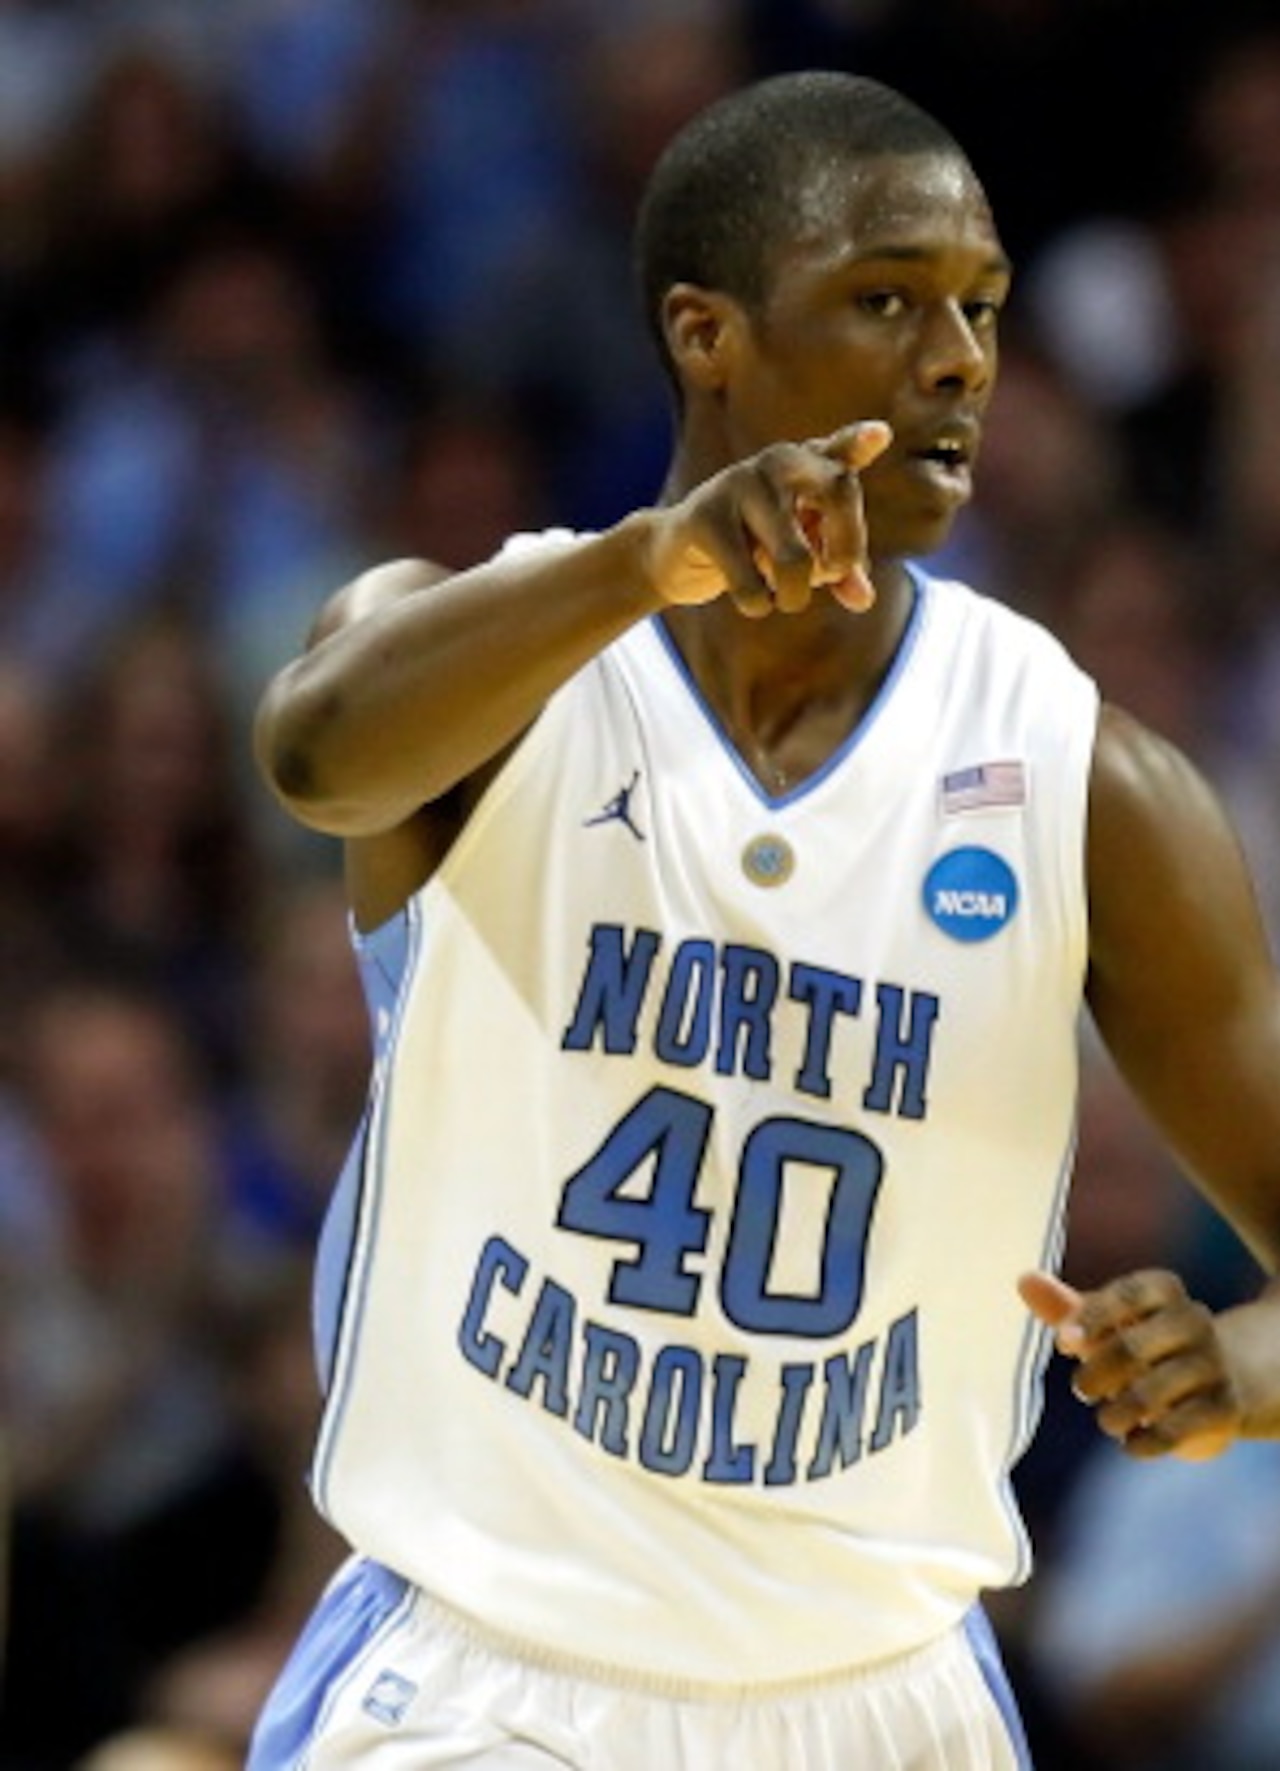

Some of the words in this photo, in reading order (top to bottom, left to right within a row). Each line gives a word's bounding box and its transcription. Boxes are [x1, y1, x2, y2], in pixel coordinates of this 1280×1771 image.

[934, 890, 1006, 919] NCAA
[560, 923, 939, 1120] NORTH
[553, 1083, 885, 1338] 40
[457, 1234, 922, 1487] CAROLINA
